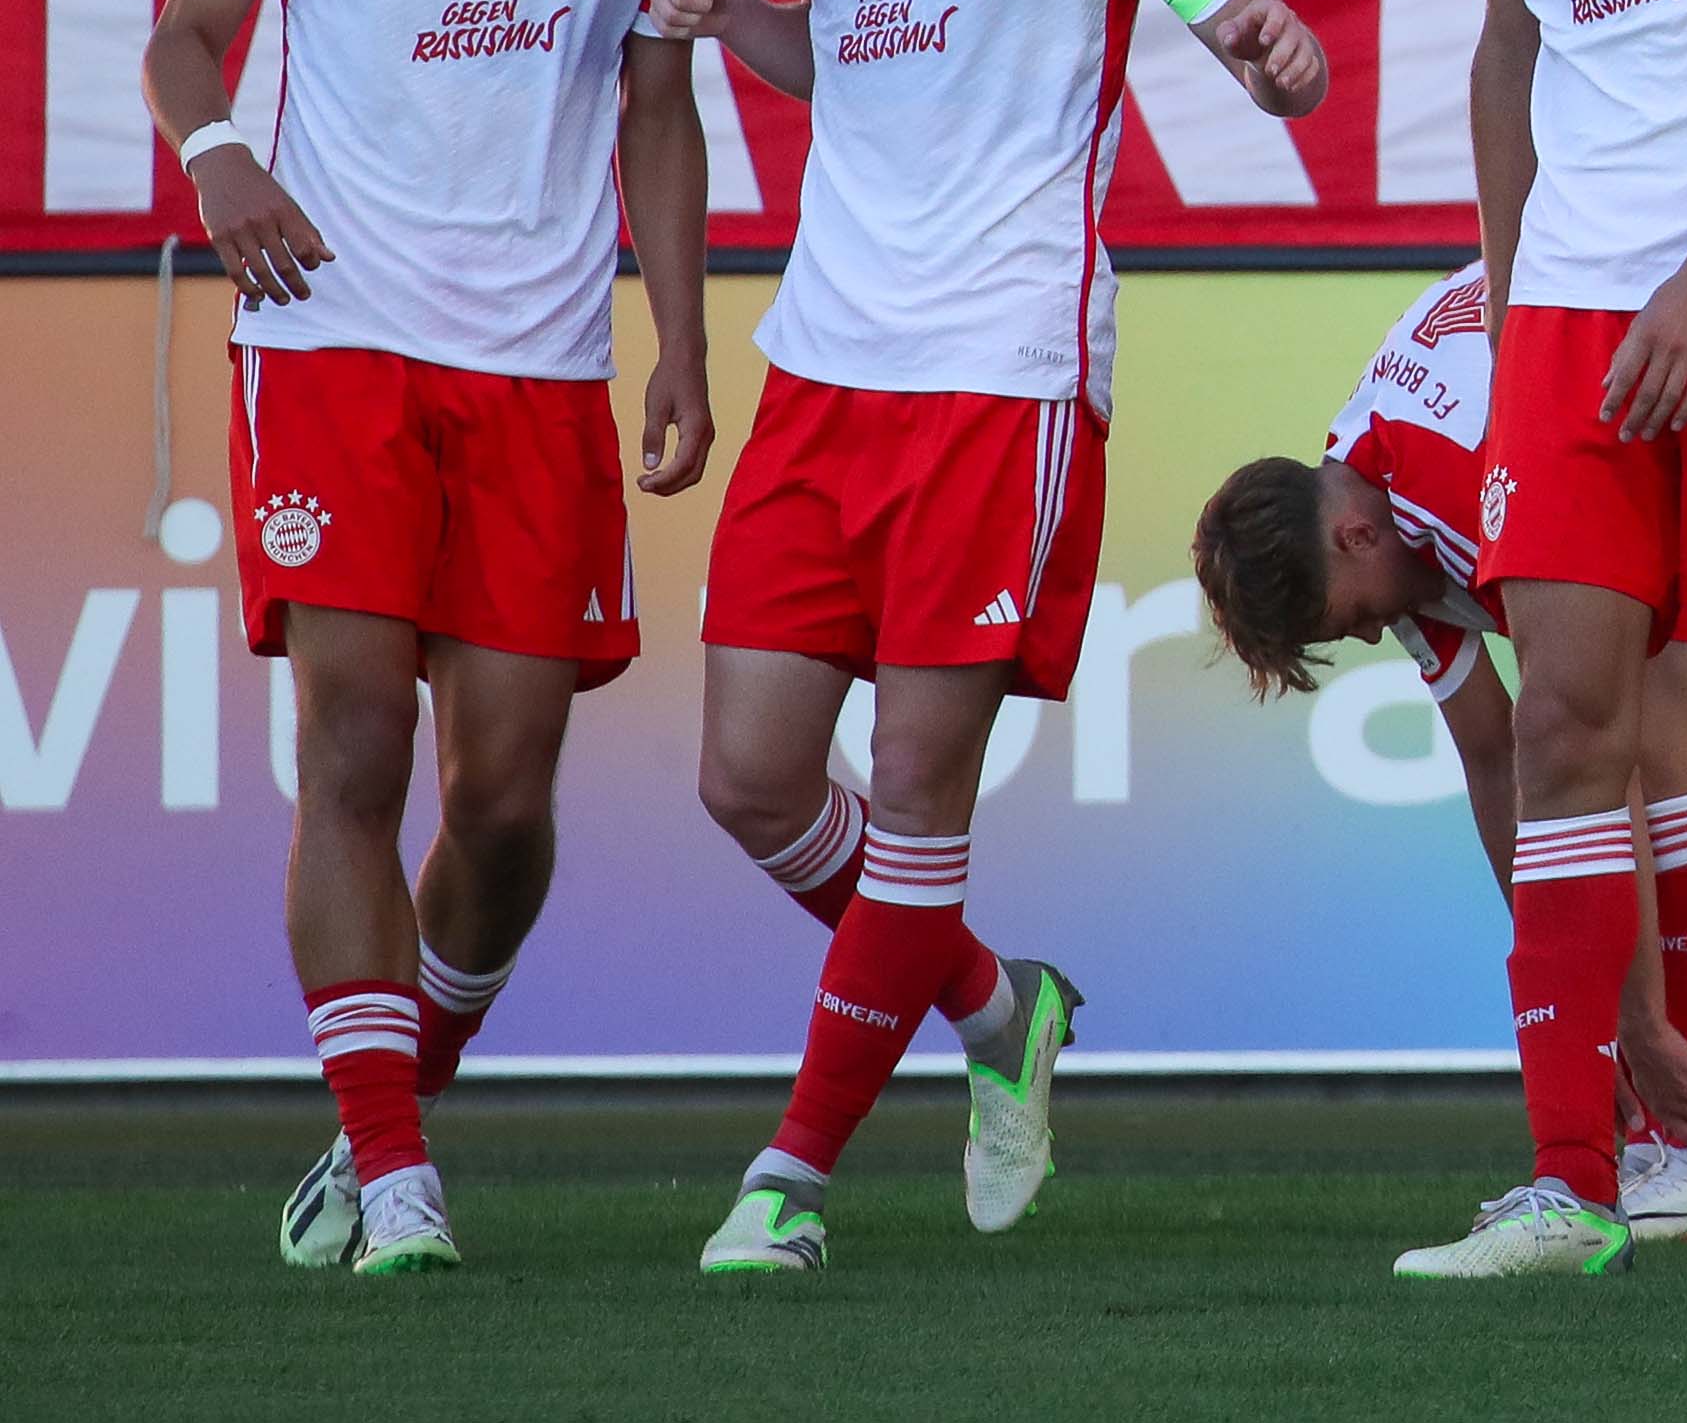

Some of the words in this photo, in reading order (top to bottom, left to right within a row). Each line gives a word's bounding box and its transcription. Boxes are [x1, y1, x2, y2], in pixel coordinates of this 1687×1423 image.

[411, 5, 572, 62] RASSISMUS
[838, 5, 959, 65] RASSISMUS
[1424, 382, 1460, 420] FC
[823, 992, 899, 1031] BAYERN
[1515, 1005, 1555, 1030] ERN
